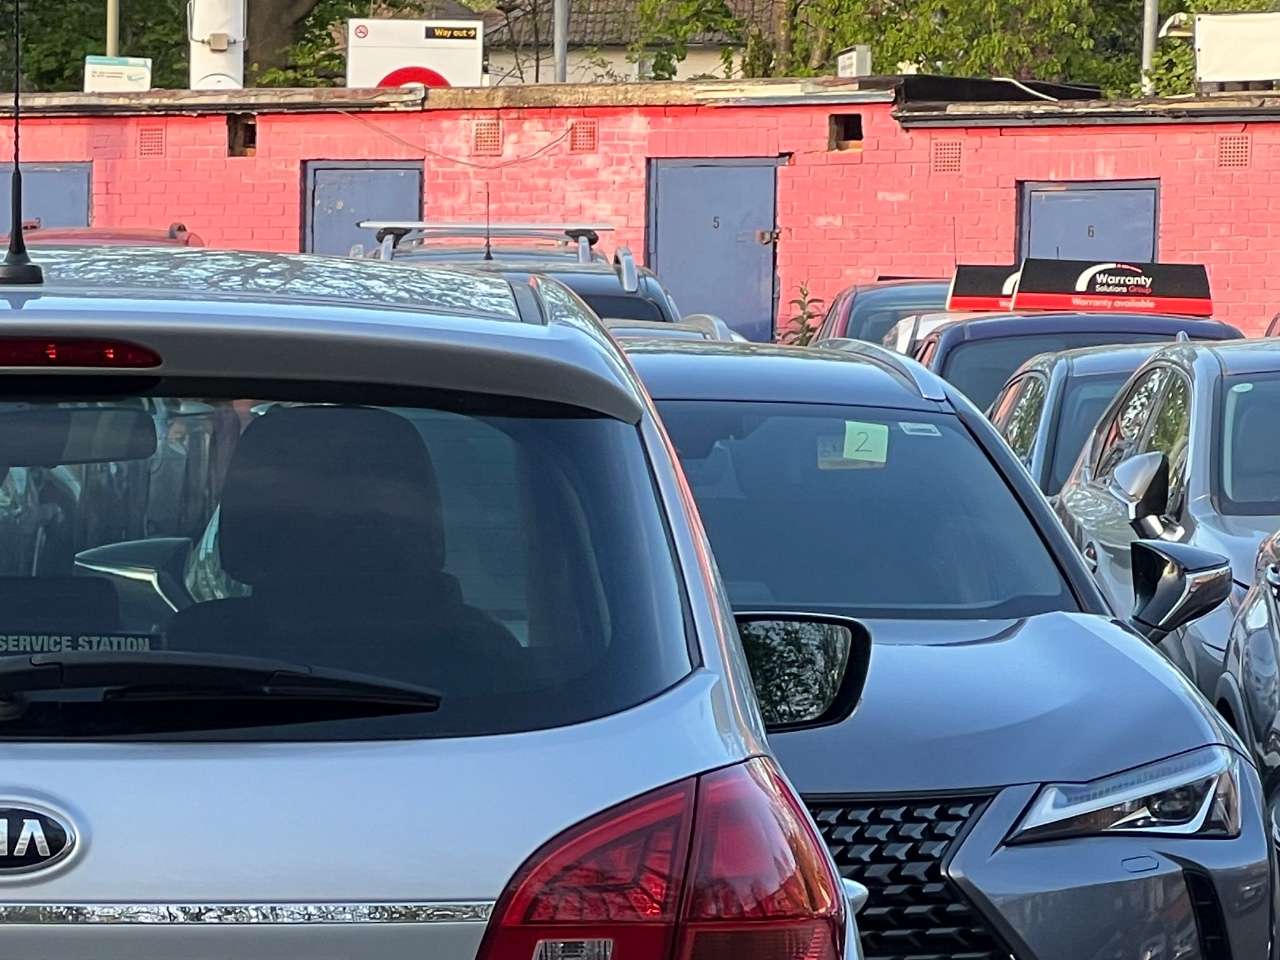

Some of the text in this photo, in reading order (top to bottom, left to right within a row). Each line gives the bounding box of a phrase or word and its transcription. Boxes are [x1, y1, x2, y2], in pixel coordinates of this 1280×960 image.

[434, 28, 452, 38] Way
[712, 215, 720, 229] 5
[1087, 224, 1095, 238] 6
[1095, 273, 1153, 288] Warranty
[1095, 285, 1153, 294] Solutions Group
[1071, 296, 1156, 309] Warranty available
[855, 431, 873, 453] 2
[77, 636, 151, 651] STATION
